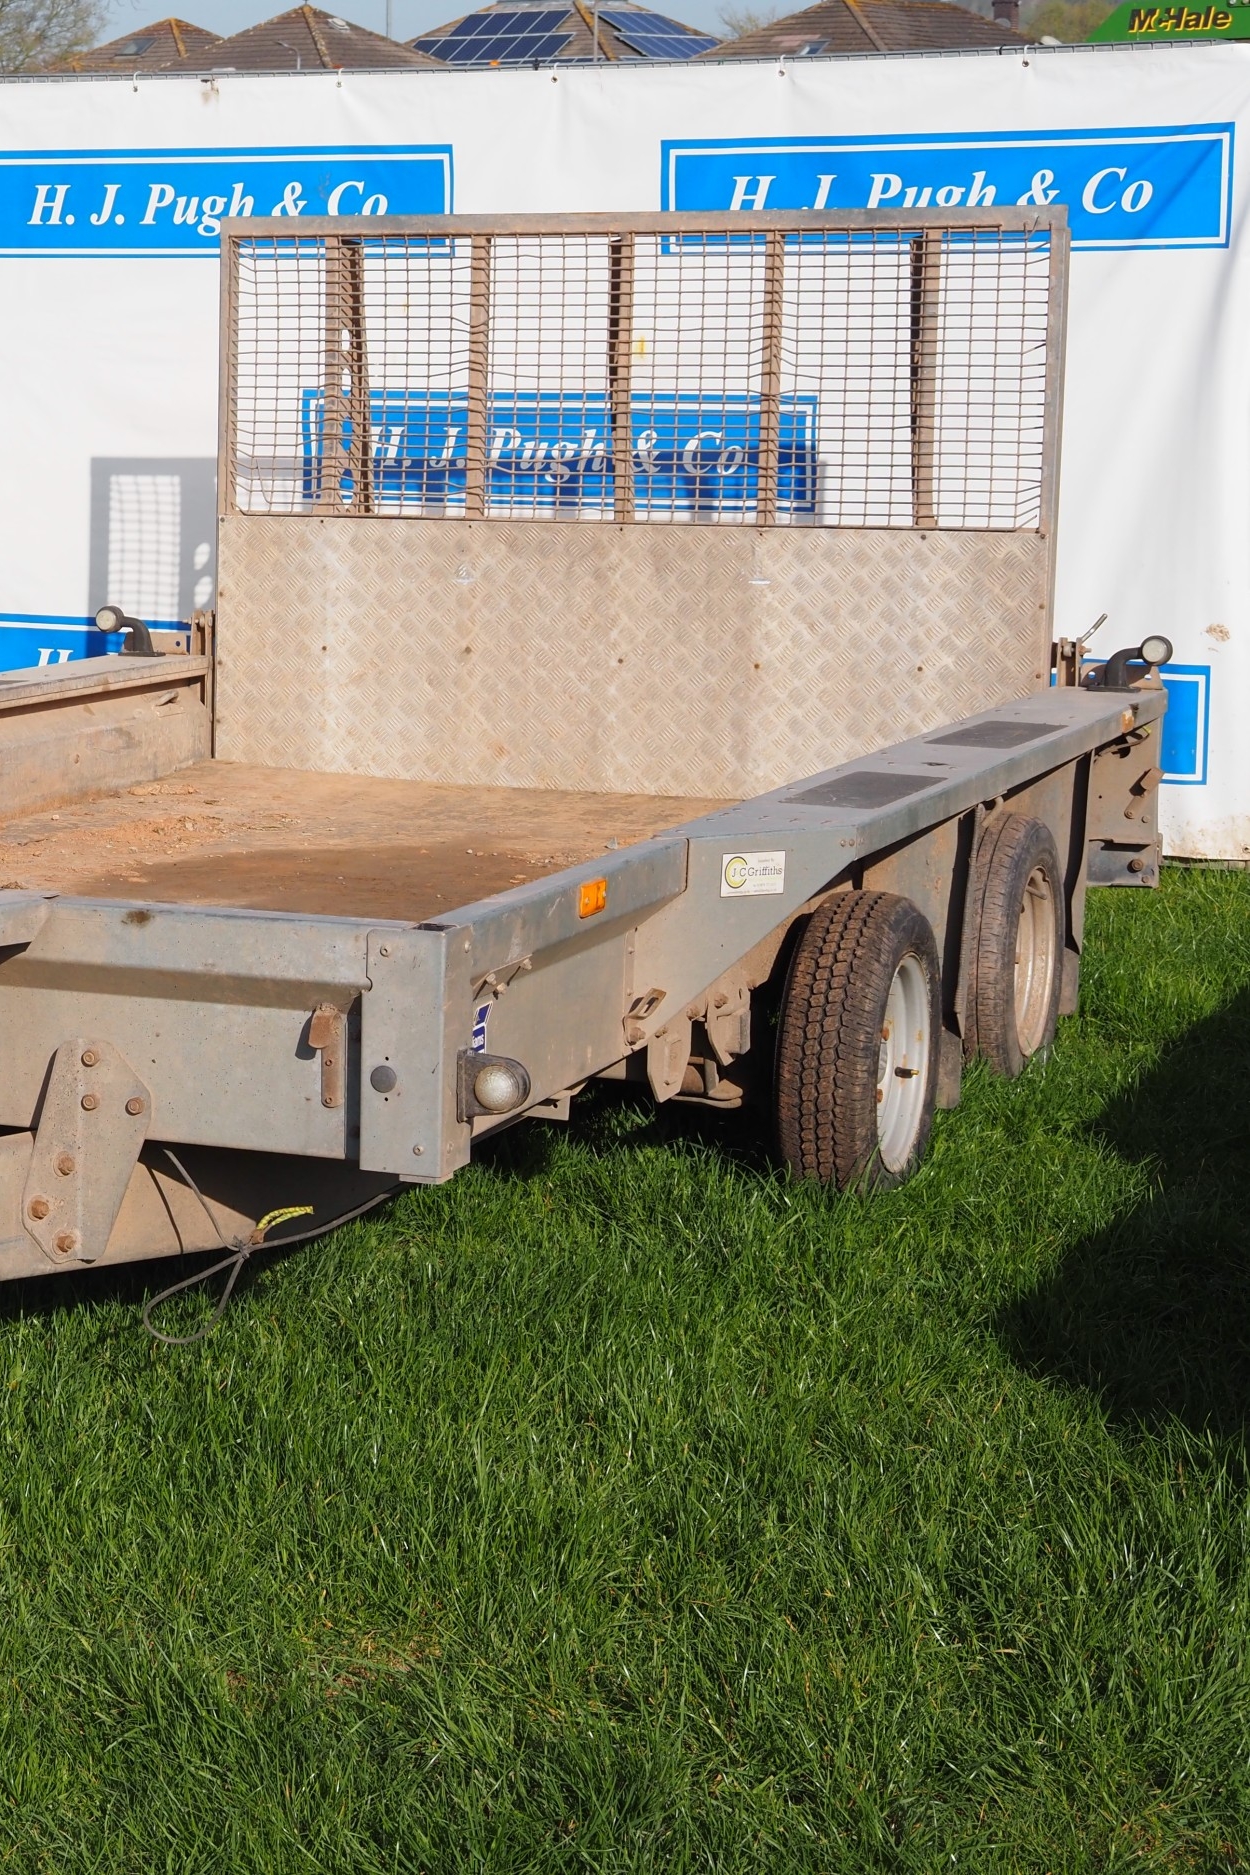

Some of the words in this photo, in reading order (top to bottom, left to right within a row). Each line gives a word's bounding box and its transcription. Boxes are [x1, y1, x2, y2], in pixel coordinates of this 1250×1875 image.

[1128, 5, 1233, 33] McHale
[27, 184, 75, 226] H.
[90, 184, 125, 226] J.
[139, 182, 255, 237] Pugh
[271, 181, 308, 217] &
[327, 180, 389, 217] Co
[1016, 169, 1061, 206] &
[1081, 166, 1154, 214] Co
[371, 426, 412, 468] H.
[430, 426, 466, 469] J.
[488, 426, 606, 482] Pugh
[632, 429, 661, 472] &
[683, 430, 746, 476] Co
[731, 867, 737, 878] J
[747, 866, 783, 877] Griffiths
